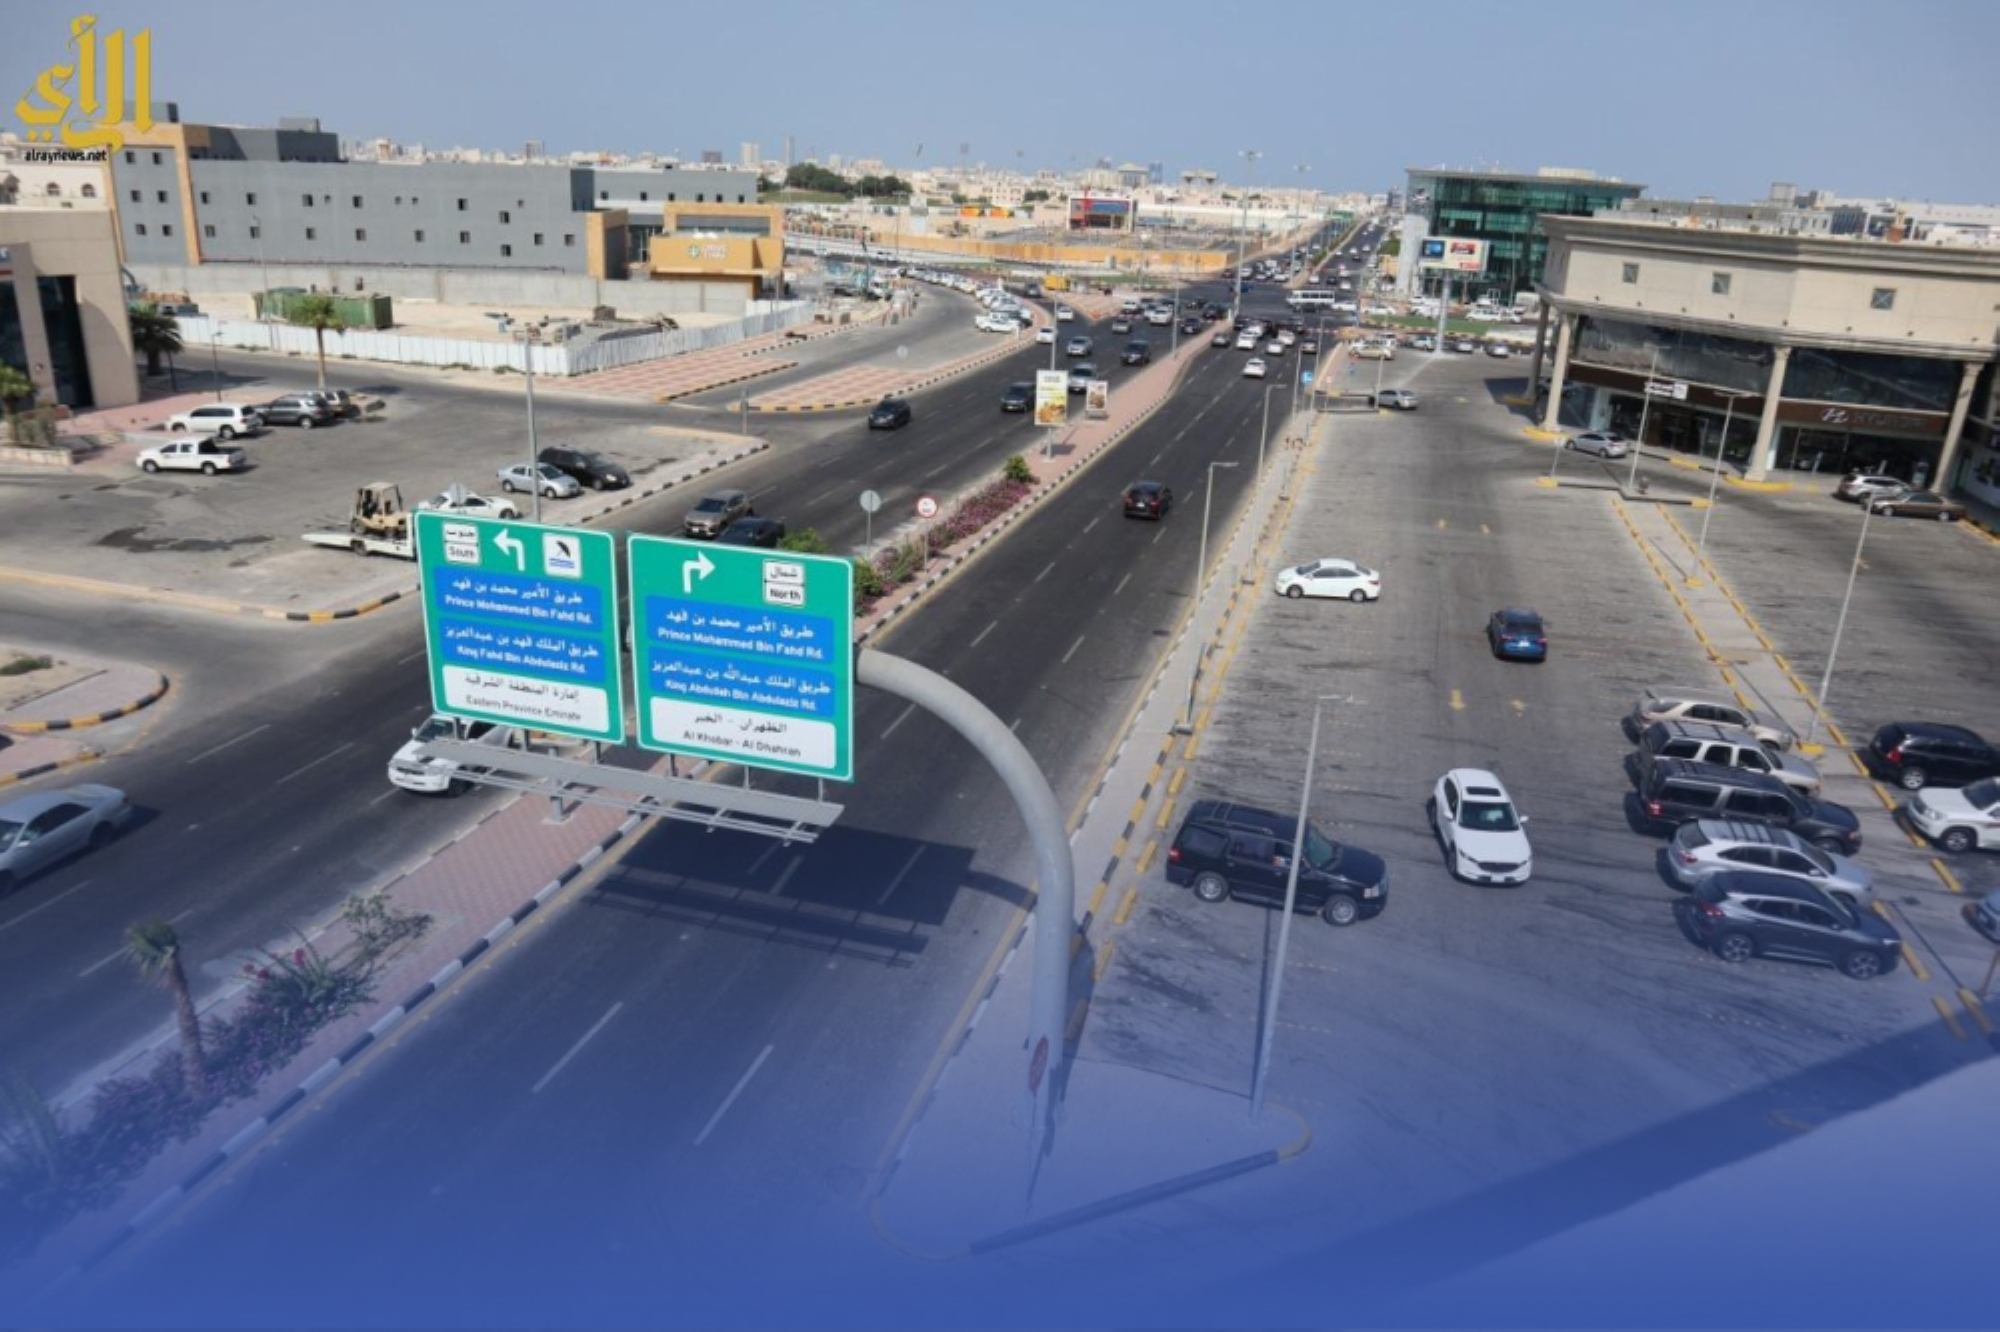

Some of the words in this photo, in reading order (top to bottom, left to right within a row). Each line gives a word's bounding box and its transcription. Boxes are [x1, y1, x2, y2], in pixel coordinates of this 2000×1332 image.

[770, 566, 797, 580] شمال
[452, 577, 471, 591] فهد
[474, 582, 487, 593] بن
[490, 583, 517, 595] محمد
[522, 582, 549, 599] الأمير
[554, 590, 583, 604] طريق
[770, 588, 801, 601] North
[445, 594, 475, 608] Prince
[476, 600, 530, 615] Mohammed
[532, 606, 549, 618] Bin
[550, 608, 575, 621] Fahd
[666, 609, 688, 623] فهد
[692, 613, 705, 625] بن
[710, 616, 740, 628] محمد
[746, 616, 776, 633] الأمير
[780, 624, 814, 639] طريق
[446, 627, 493, 642] عبدالعزيز
[497, 634, 509, 646] بن
[512, 634, 533, 648] فهد
[658, 627, 691, 642] Prince
[693, 632, 753, 649] Mohammed
[756, 640, 774, 652] Bin
[776, 643, 804, 657] Fahd
[536, 638, 565, 651] الملك
[568, 642, 598, 657] طريق
[457, 645, 479, 660] King
[480, 648, 503, 661] Fahd
[504, 651, 521, 663] Bin
[652, 660, 702, 676] عبدالعزيز
[706, 667, 719, 680] بن
[465, 672, 504, 688] الشرقية
[508, 679, 549, 695] المنطقة
[765, 674, 796, 688] الملك
[798, 679, 831, 695] طريق
[552, 687, 579, 702] إمارة
[664, 679, 686, 694] King
[733, 688, 749, 700] Bin
[466, 694, 501, 709] Eastern
[502, 700, 542, 714] Province
[544, 708, 581, 720] Emirate
[694, 714, 722, 723] الخبر
[739, 718, 787, 733] الظهران
[684, 730, 695, 740] Al
[697, 732, 733, 746] Khobar
[742, 739, 753, 749] Al
[756, 741, 801, 756] Dhahran
